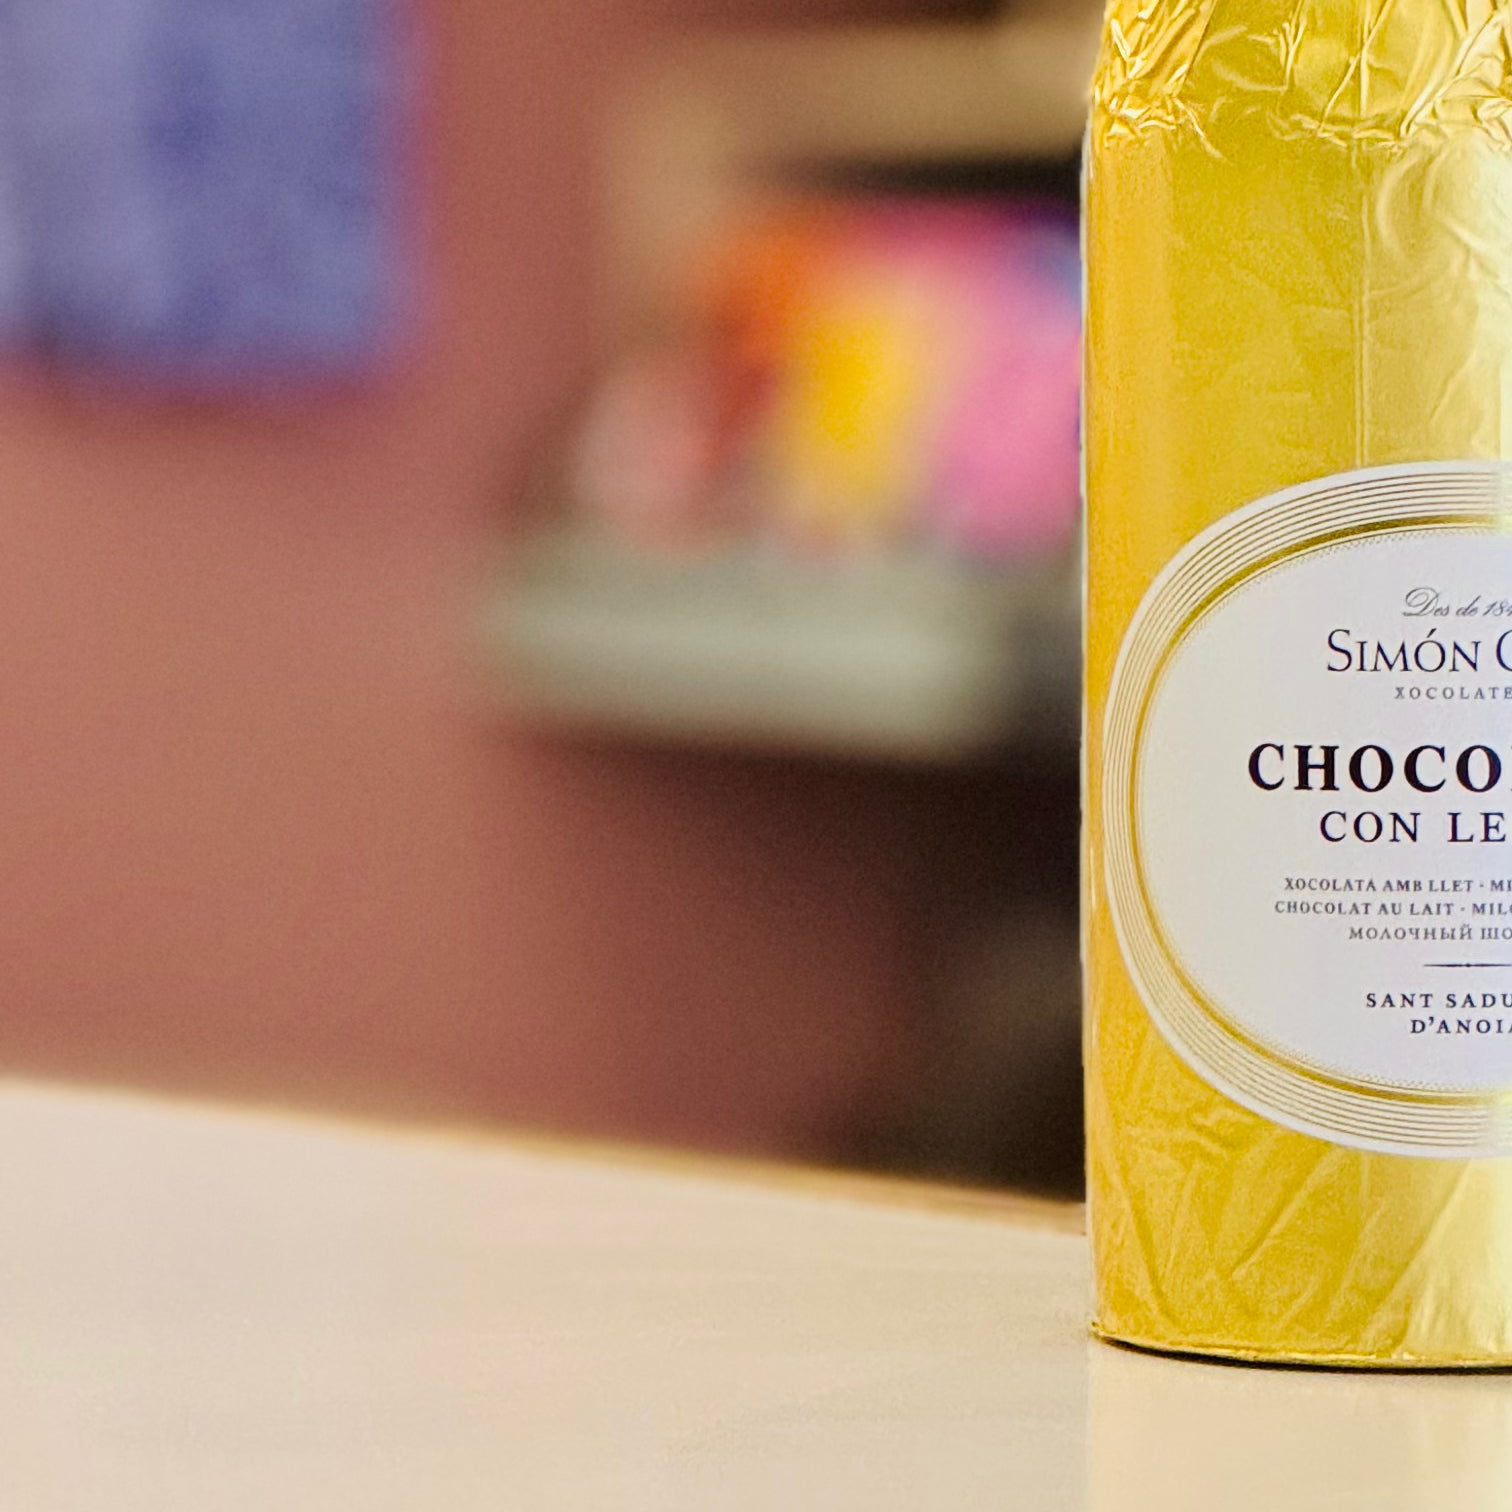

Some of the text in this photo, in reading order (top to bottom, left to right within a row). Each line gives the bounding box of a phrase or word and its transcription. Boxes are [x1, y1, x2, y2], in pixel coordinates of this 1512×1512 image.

[1402, 586, 1450, 618] Des
[1454, 594, 1481, 618] de
[1327, 627, 1482, 673] SIMÓN
[1319, 810, 1421, 843] CON
[1284, 876, 1378, 893] XOCOLATA
[1381, 879, 1423, 893] AMB
[1427, 879, 1474, 893] LLET
[1274, 900, 1373, 916] CHOCOLAT
[1376, 902, 1402, 916] AU
[1409, 902, 1455, 916] LAIT
[1348, 923, 1473, 941] МОЛОЧНЫЙ
[1366, 992, 1434, 1009] SANT
